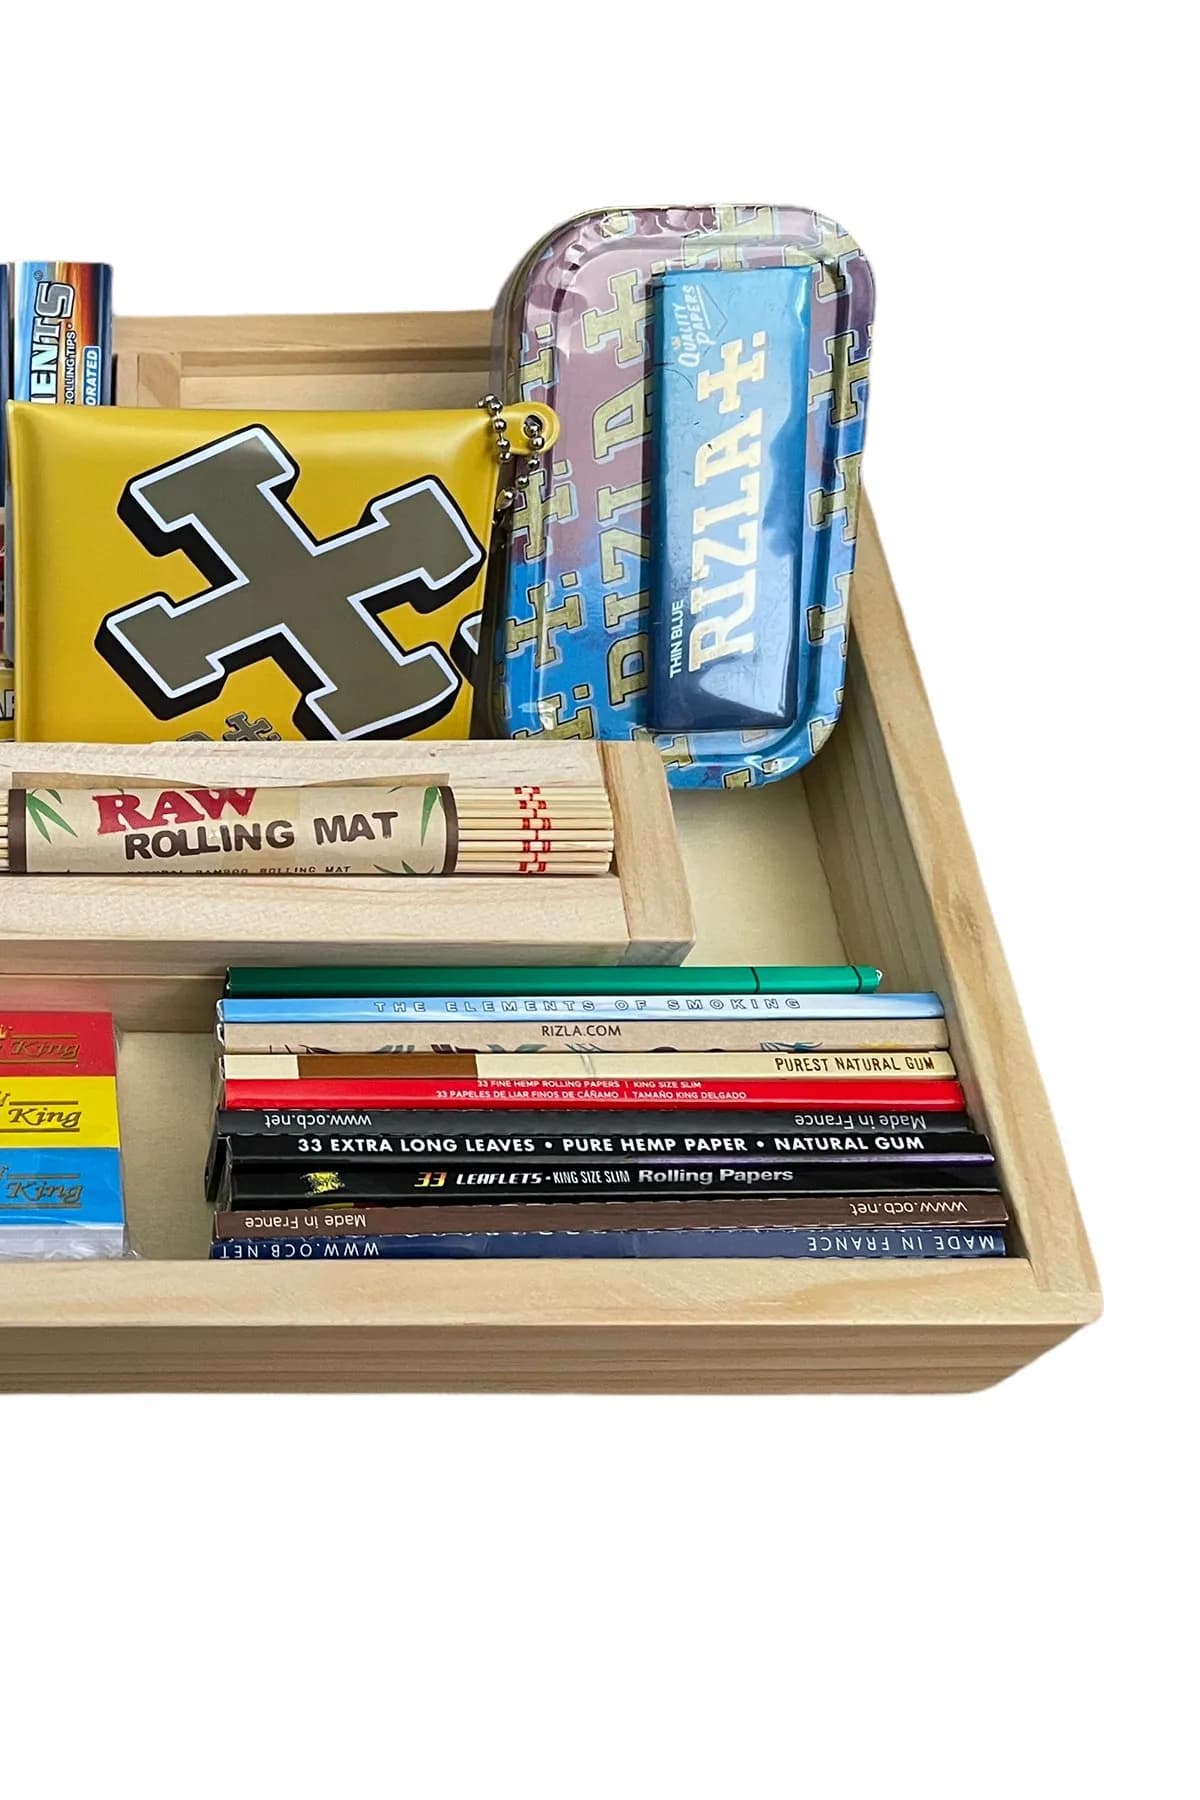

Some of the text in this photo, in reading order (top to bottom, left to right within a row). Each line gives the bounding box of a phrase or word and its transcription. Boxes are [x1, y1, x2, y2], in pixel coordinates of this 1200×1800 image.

[676, 284, 716, 368] QUALITY PAPERS
[66, 330, 76, 365] TIPS
[669, 598, 684, 678] THIN BLUE
[91, 787, 257, 834] RAW
[123, 811, 399, 861] ROLLING MAT
[374, 998, 801, 1013] THE ELEMENTS OF SMOKING
[541, 1025, 622, 1037] RIZLA.COM
[10, 1038, 81, 1060] King
[774, 1056, 935, 1072] PUREST NATURAL GUM
[477, 1080, 702, 1088] 33 FINE HEMP ROLLING PAPERS KING SIZE SLIM
[436, 1090, 448, 1099] 33
[449, 1090, 492, 1099] PAPELES
[493, 1090, 506, 1099] DE
[508, 1090, 530, 1099] LIAR
[531, 1090, 560, 1099] FINOS
[562, 1090, 574, 1099] DE
[632, 1090, 673, 1100] TAMAÑO
[676, 1091, 699, 1100] KING
[701, 1091, 747, 1100] DELGADO
[8, 1106, 83, 1128] King
[264, 1114, 372, 1128] www.ocb.net
[794, 1113, 927, 1129] Made in France
[297, 1135, 926, 1153] 33 EXTRA LONG LEAVES PURE HEMP PAPER NATURAL GUM
[413, 1167, 794, 1188] 33 LEAFLETS KING SIZE SLIM Rolling Papers
[6, 1179, 84, 1204] King
[850, 1200, 968, 1216] www.ocb.net
[245, 1213, 367, 1229] Made in France
[220, 1241, 380, 1259] WWW.OCB.NET
[808, 1235, 995, 1252] MADE IN FRANCE
